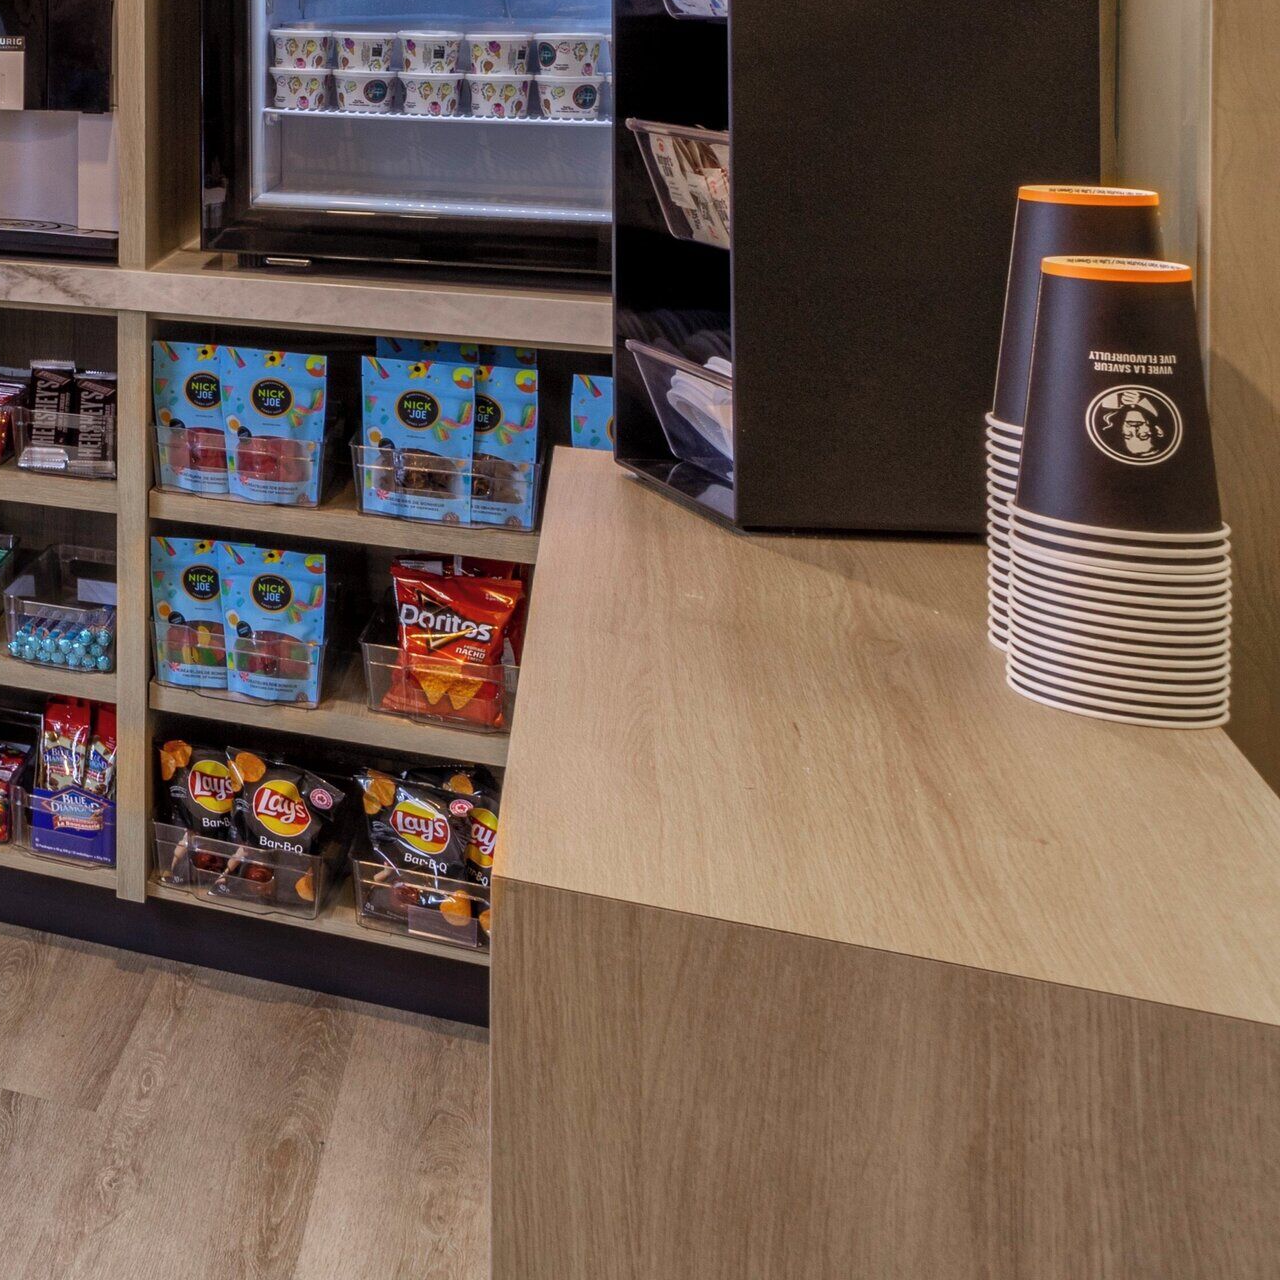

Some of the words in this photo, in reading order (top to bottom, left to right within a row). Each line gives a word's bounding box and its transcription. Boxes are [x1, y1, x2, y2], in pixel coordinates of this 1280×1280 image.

[1088, 350, 1158, 364] FLAVOURFULLY
[1158, 355, 1178, 364] LIVE
[1094, 362, 1132, 374] SAVEUR
[1133, 365, 1146, 374] LA
[1148, 366, 1174, 375] VIVRE
[191, 382, 217, 392] NICK
[197, 391, 213, 399] JOE
[258, 389, 286, 399] NICK
[264, 398, 281, 407] JOE
[403, 400, 432, 412] NICK
[31, 380, 60, 445] HERSHEY'S
[409, 410, 427, 420] JOE
[77, 391, 105, 458] HERSHEY'S
[188, 573, 215, 583] NICK
[194, 582, 211, 592] JOE
[258, 583, 285, 594] NICK
[263, 592, 281, 602] JOE
[400, 603, 491, 641] Doritos
[62, 793, 87, 805] BLUE
[50, 801, 100, 814] DIAMOND
[256, 793, 307, 824] Lay's
[396, 810, 447, 843] Lay's
